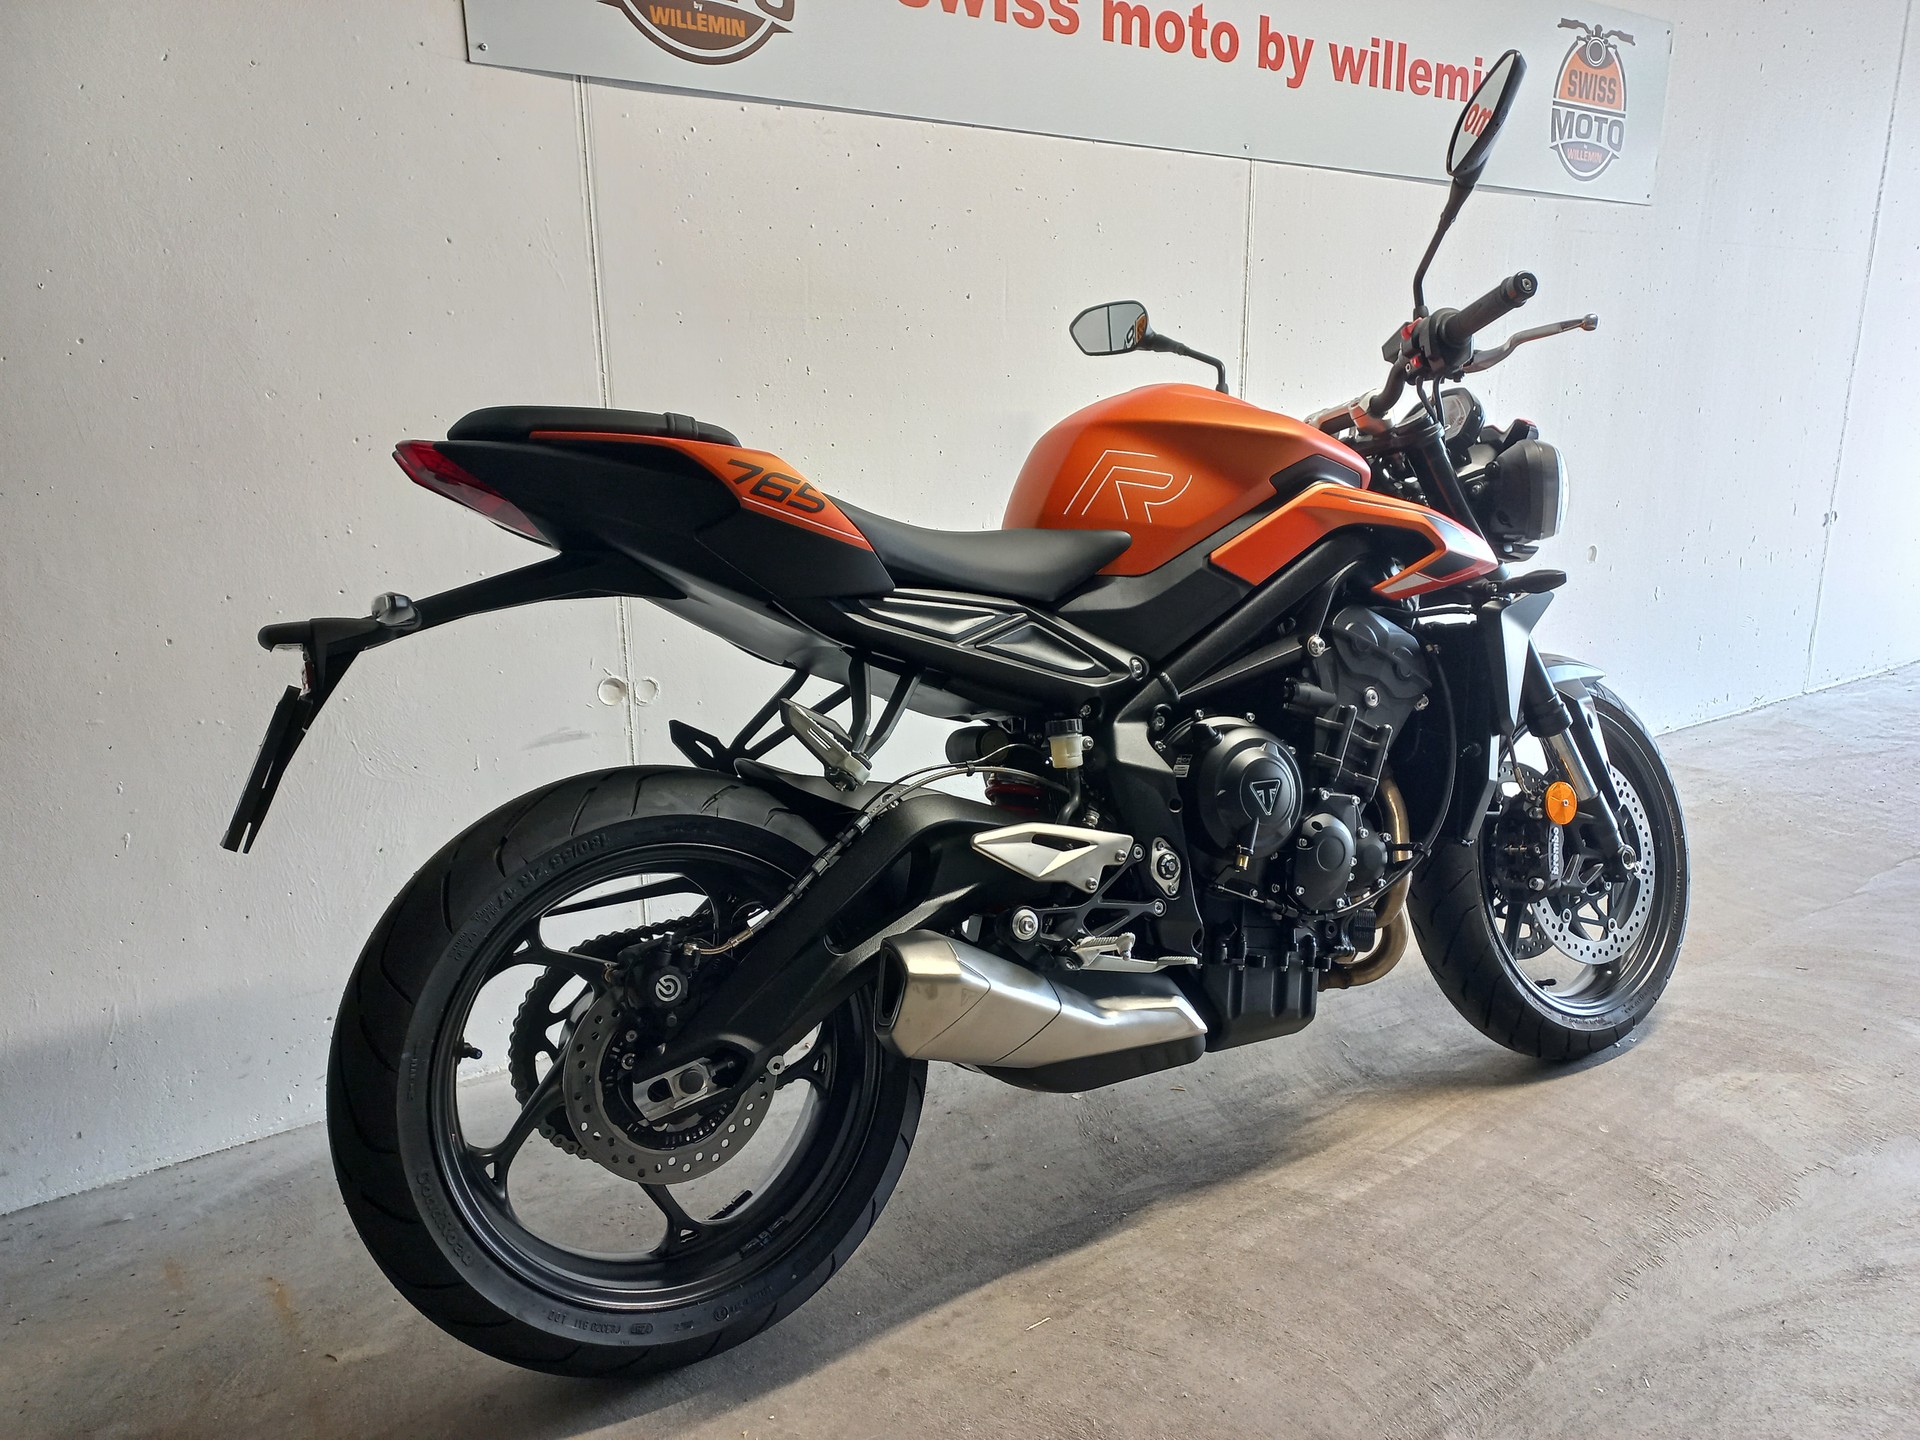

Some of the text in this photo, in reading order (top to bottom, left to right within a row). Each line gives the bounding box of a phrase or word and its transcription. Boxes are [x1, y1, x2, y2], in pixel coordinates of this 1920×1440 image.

[650, 5, 746, 37] WILLEMIN
[1102, 0, 1239, 63] moto
[1258, 14, 1314, 88] by
[1329, 37, 1489, 102] willemi
[1567, 69, 1616, 104] SWISS
[1551, 107, 1624, 152] MOTO
[1567, 148, 1602, 163] WILLEMIN
[728, 459, 825, 513] 765
[1064, 449, 1192, 524] R
[1551, 826, 1559, 875] brembo
